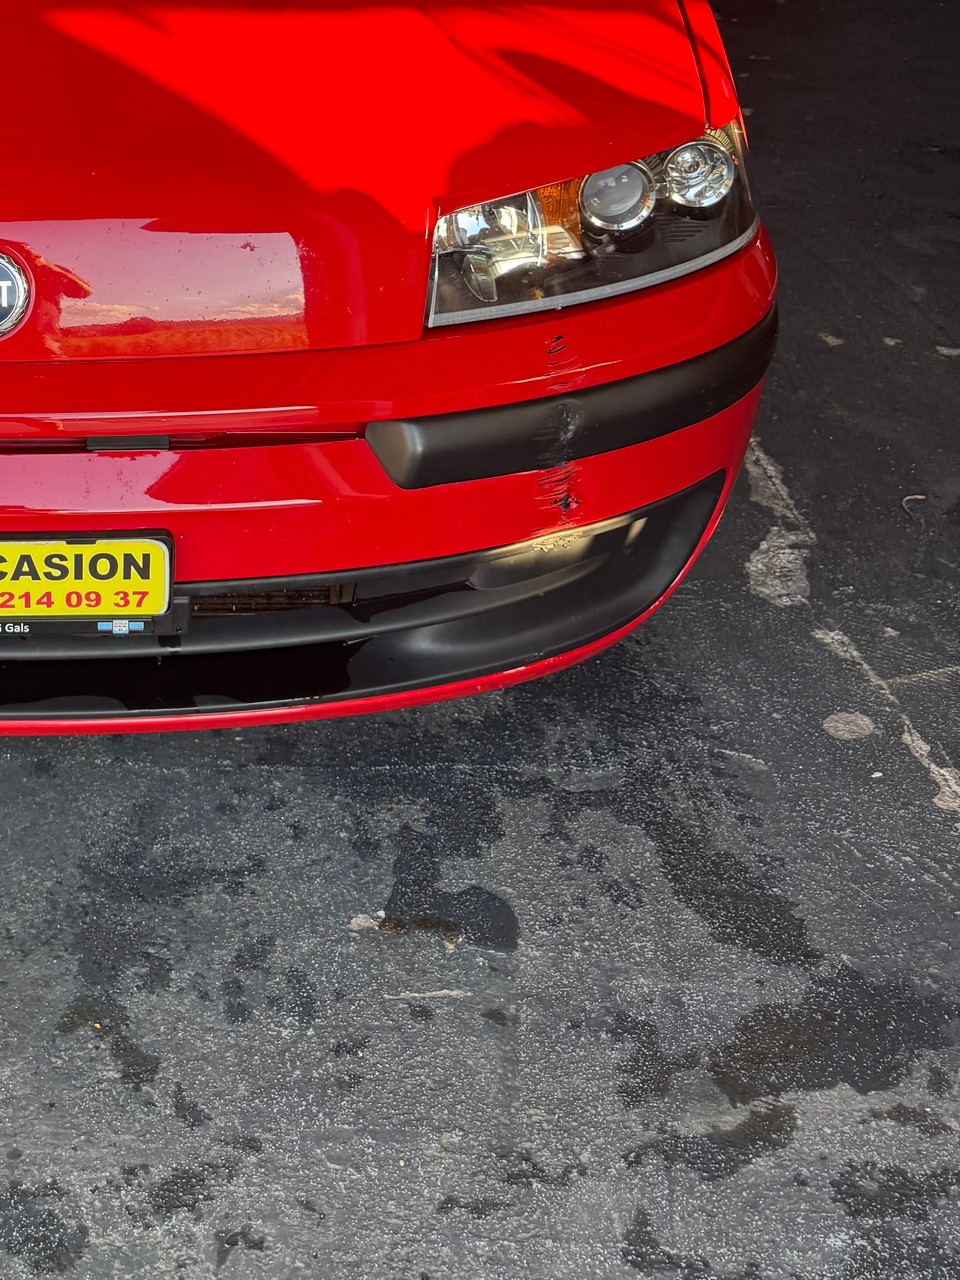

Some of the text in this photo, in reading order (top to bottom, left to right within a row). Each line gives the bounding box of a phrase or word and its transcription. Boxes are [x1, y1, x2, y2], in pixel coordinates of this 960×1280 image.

[65, 591, 102, 609] 09
[113, 590, 150, 608] 37
[4, 622, 30, 634] Gals
